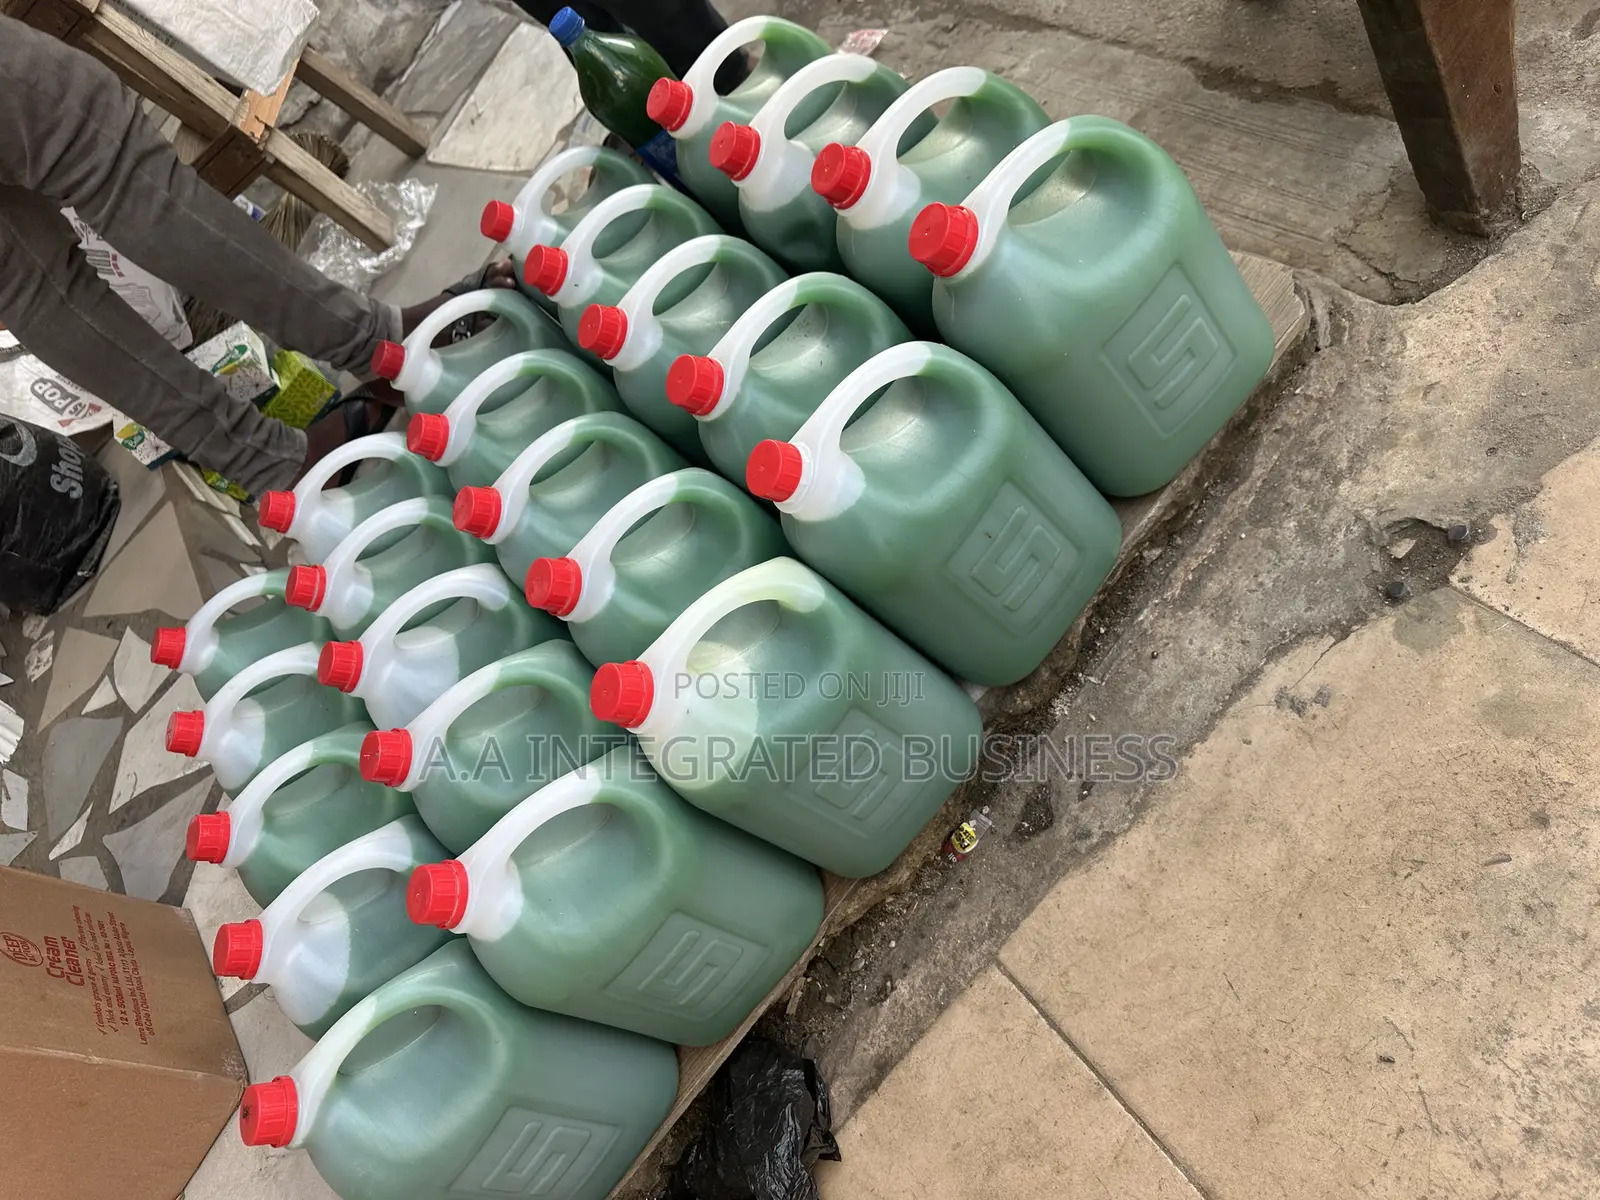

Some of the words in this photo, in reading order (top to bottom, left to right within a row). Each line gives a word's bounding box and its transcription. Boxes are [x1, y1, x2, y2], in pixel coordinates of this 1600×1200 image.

[33, 381, 69, 409] POP
[3, 935, 28, 960] DEEP
[20, 940, 37, 962] ACTION
[44, 936, 65, 978] Cream
[61, 936, 85, 986] Cleaner
[113, 986, 126, 1008] 500ml
[120, 1017, 128, 1025] 12
